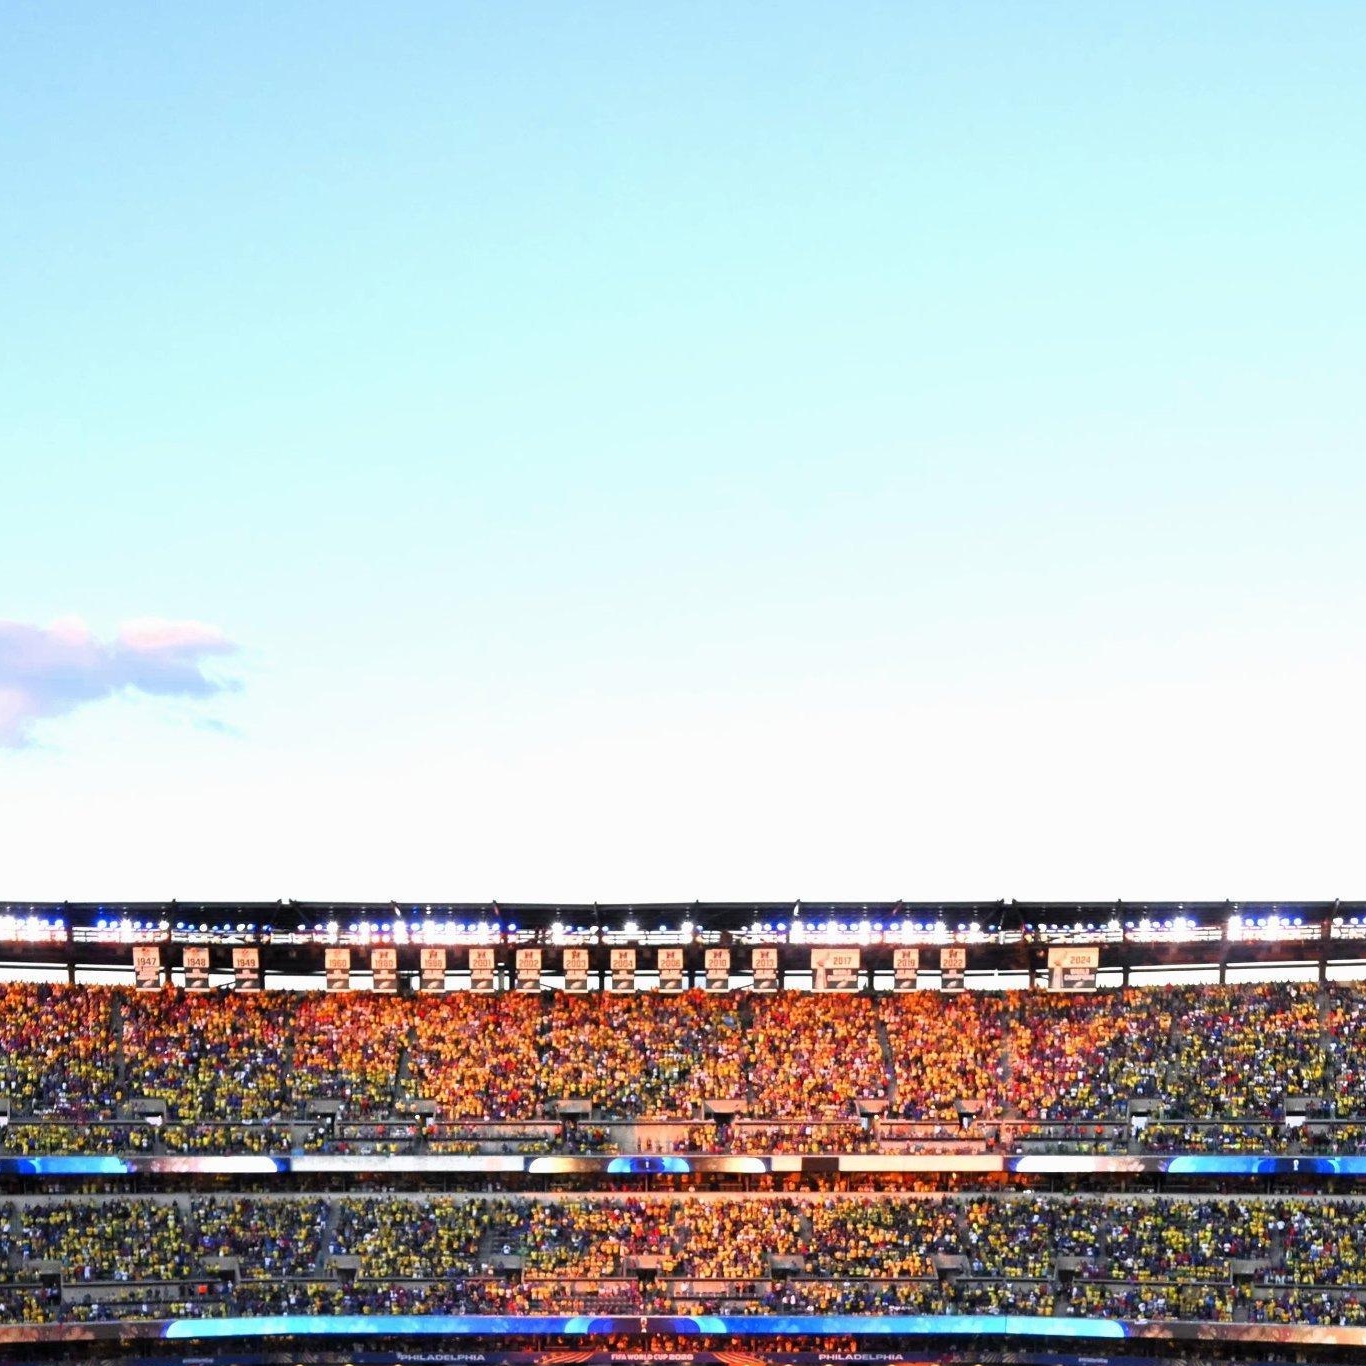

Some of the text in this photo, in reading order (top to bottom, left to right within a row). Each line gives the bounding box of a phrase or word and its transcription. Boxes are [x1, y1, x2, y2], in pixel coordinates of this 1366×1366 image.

[833, 956, 852, 966] 2017
[1070, 955, 1091, 965] 2024
[611, 1353, 626, 1362] FIFA
[626, 1353, 652, 1362] WORLD
[653, 1353, 668, 1362] CUP
[818, 1353, 904, 1361] PHILADELPHIA
